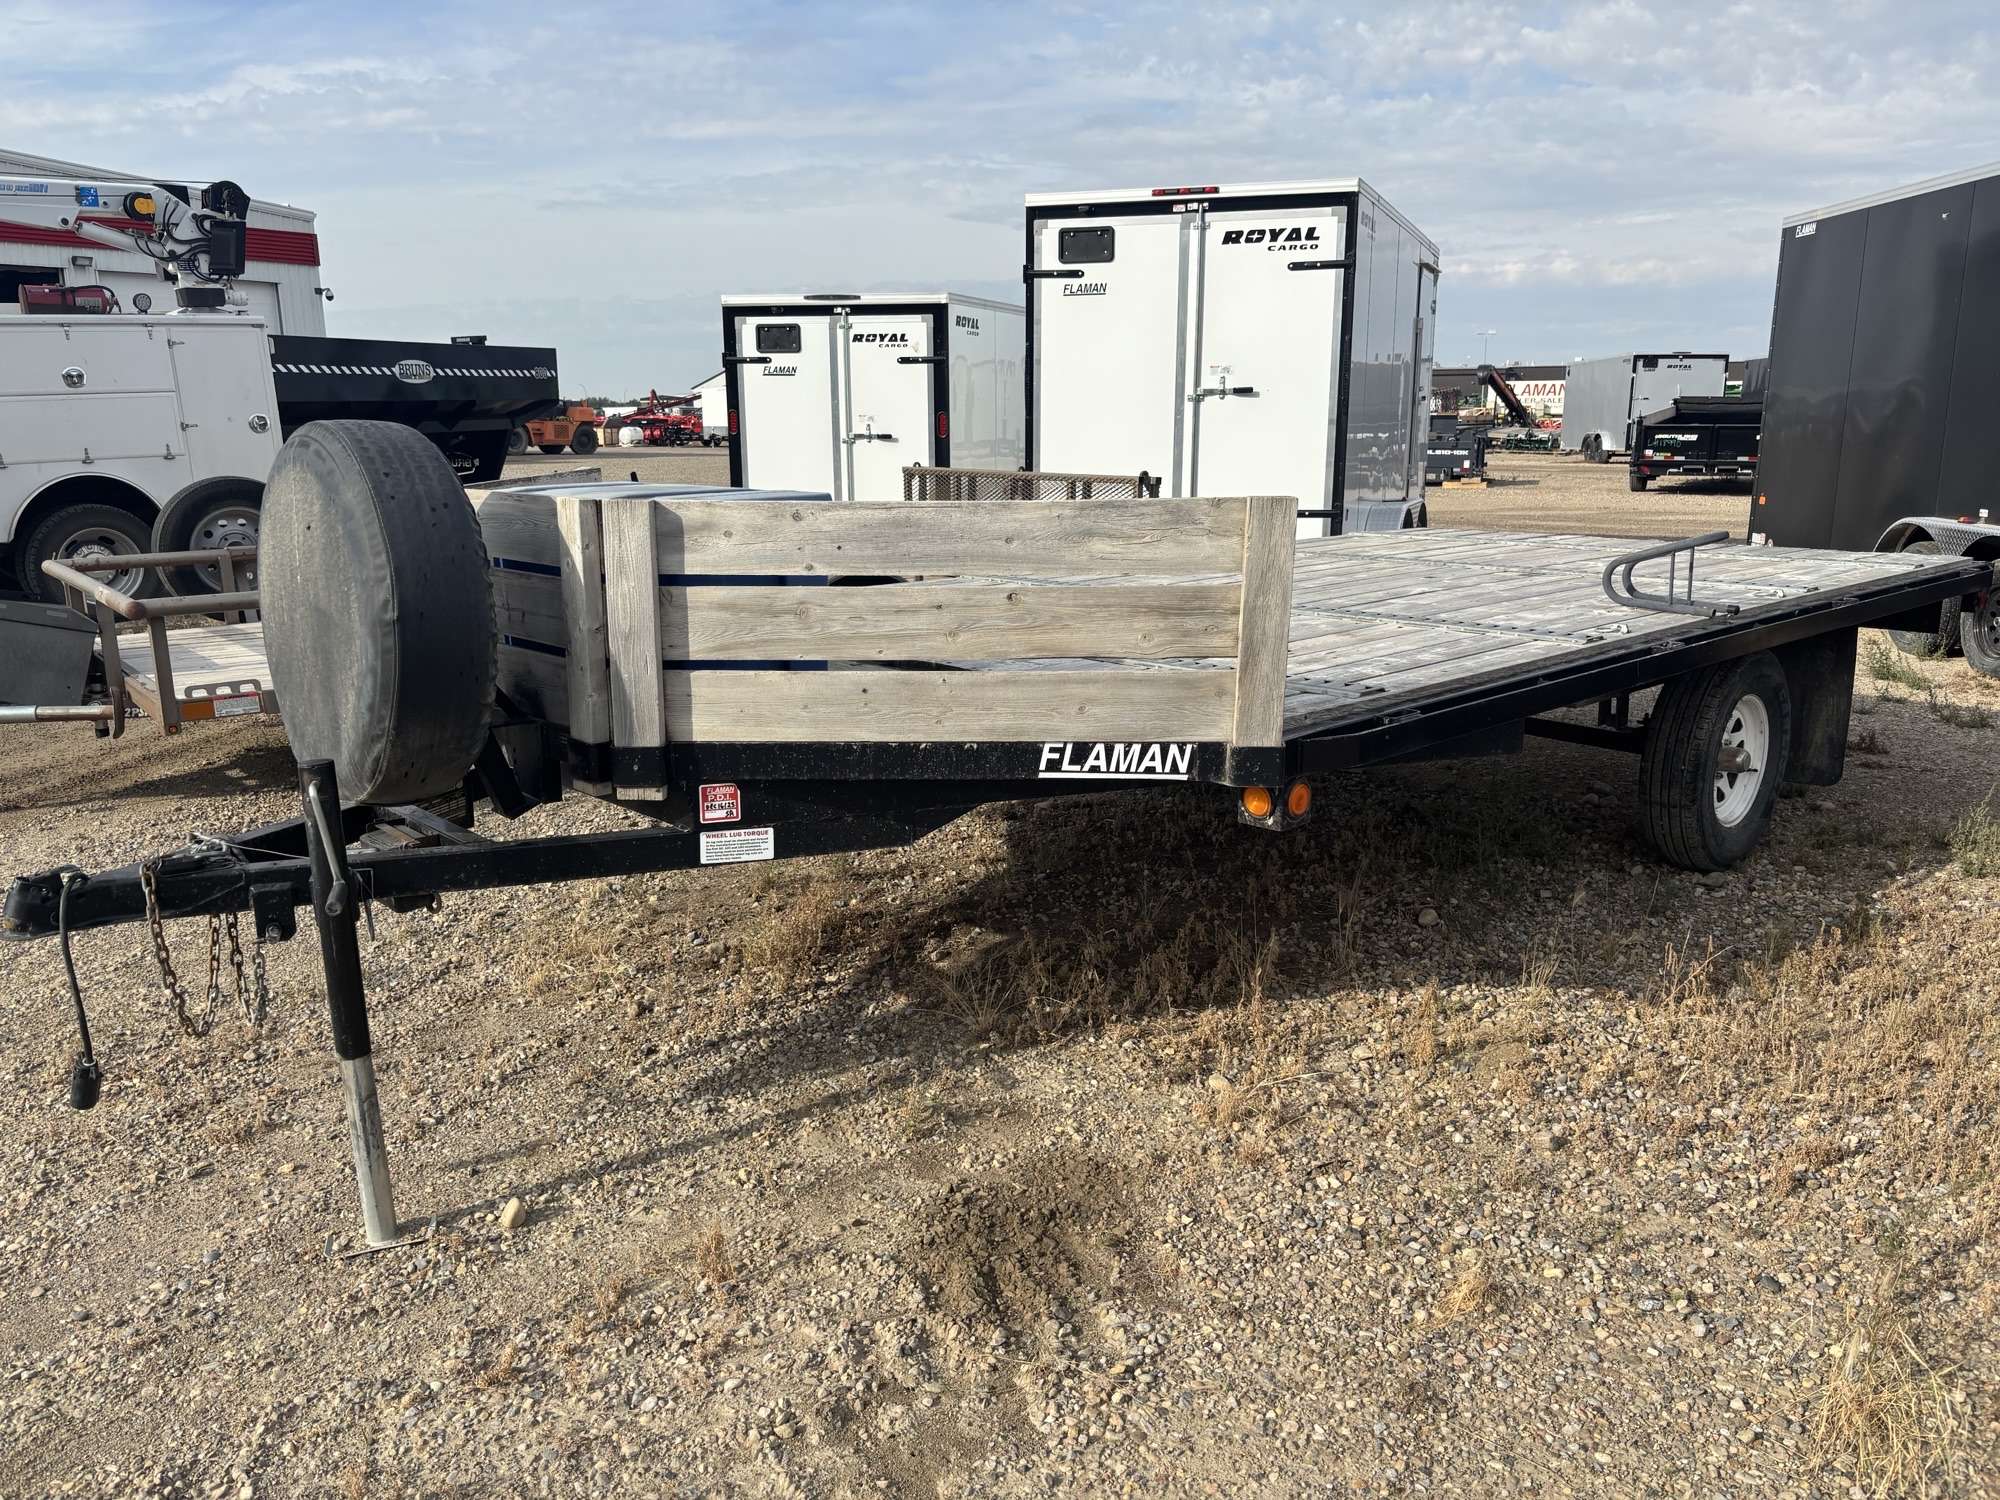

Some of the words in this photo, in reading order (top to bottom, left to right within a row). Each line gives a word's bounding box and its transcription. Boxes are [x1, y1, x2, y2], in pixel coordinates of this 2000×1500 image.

[1796, 222, 1816, 236] FLAMAN
[1221, 226, 1321, 245] ROYAL
[1267, 243, 1319, 252] CARGO
[1063, 282, 1107, 295] FLAMAN
[955, 315, 979, 330] ROYAL
[852, 333, 909, 343] ROYAL
[398, 363, 431, 377] BRUNS
[763, 365, 797, 375] FLAMAN
[1038, 742, 1193, 774] FLAMAN
[707, 786, 735, 795] FLAMAN
[708, 793, 732, 802] P.D.I.
[743, 829, 769, 837] TORQUE
